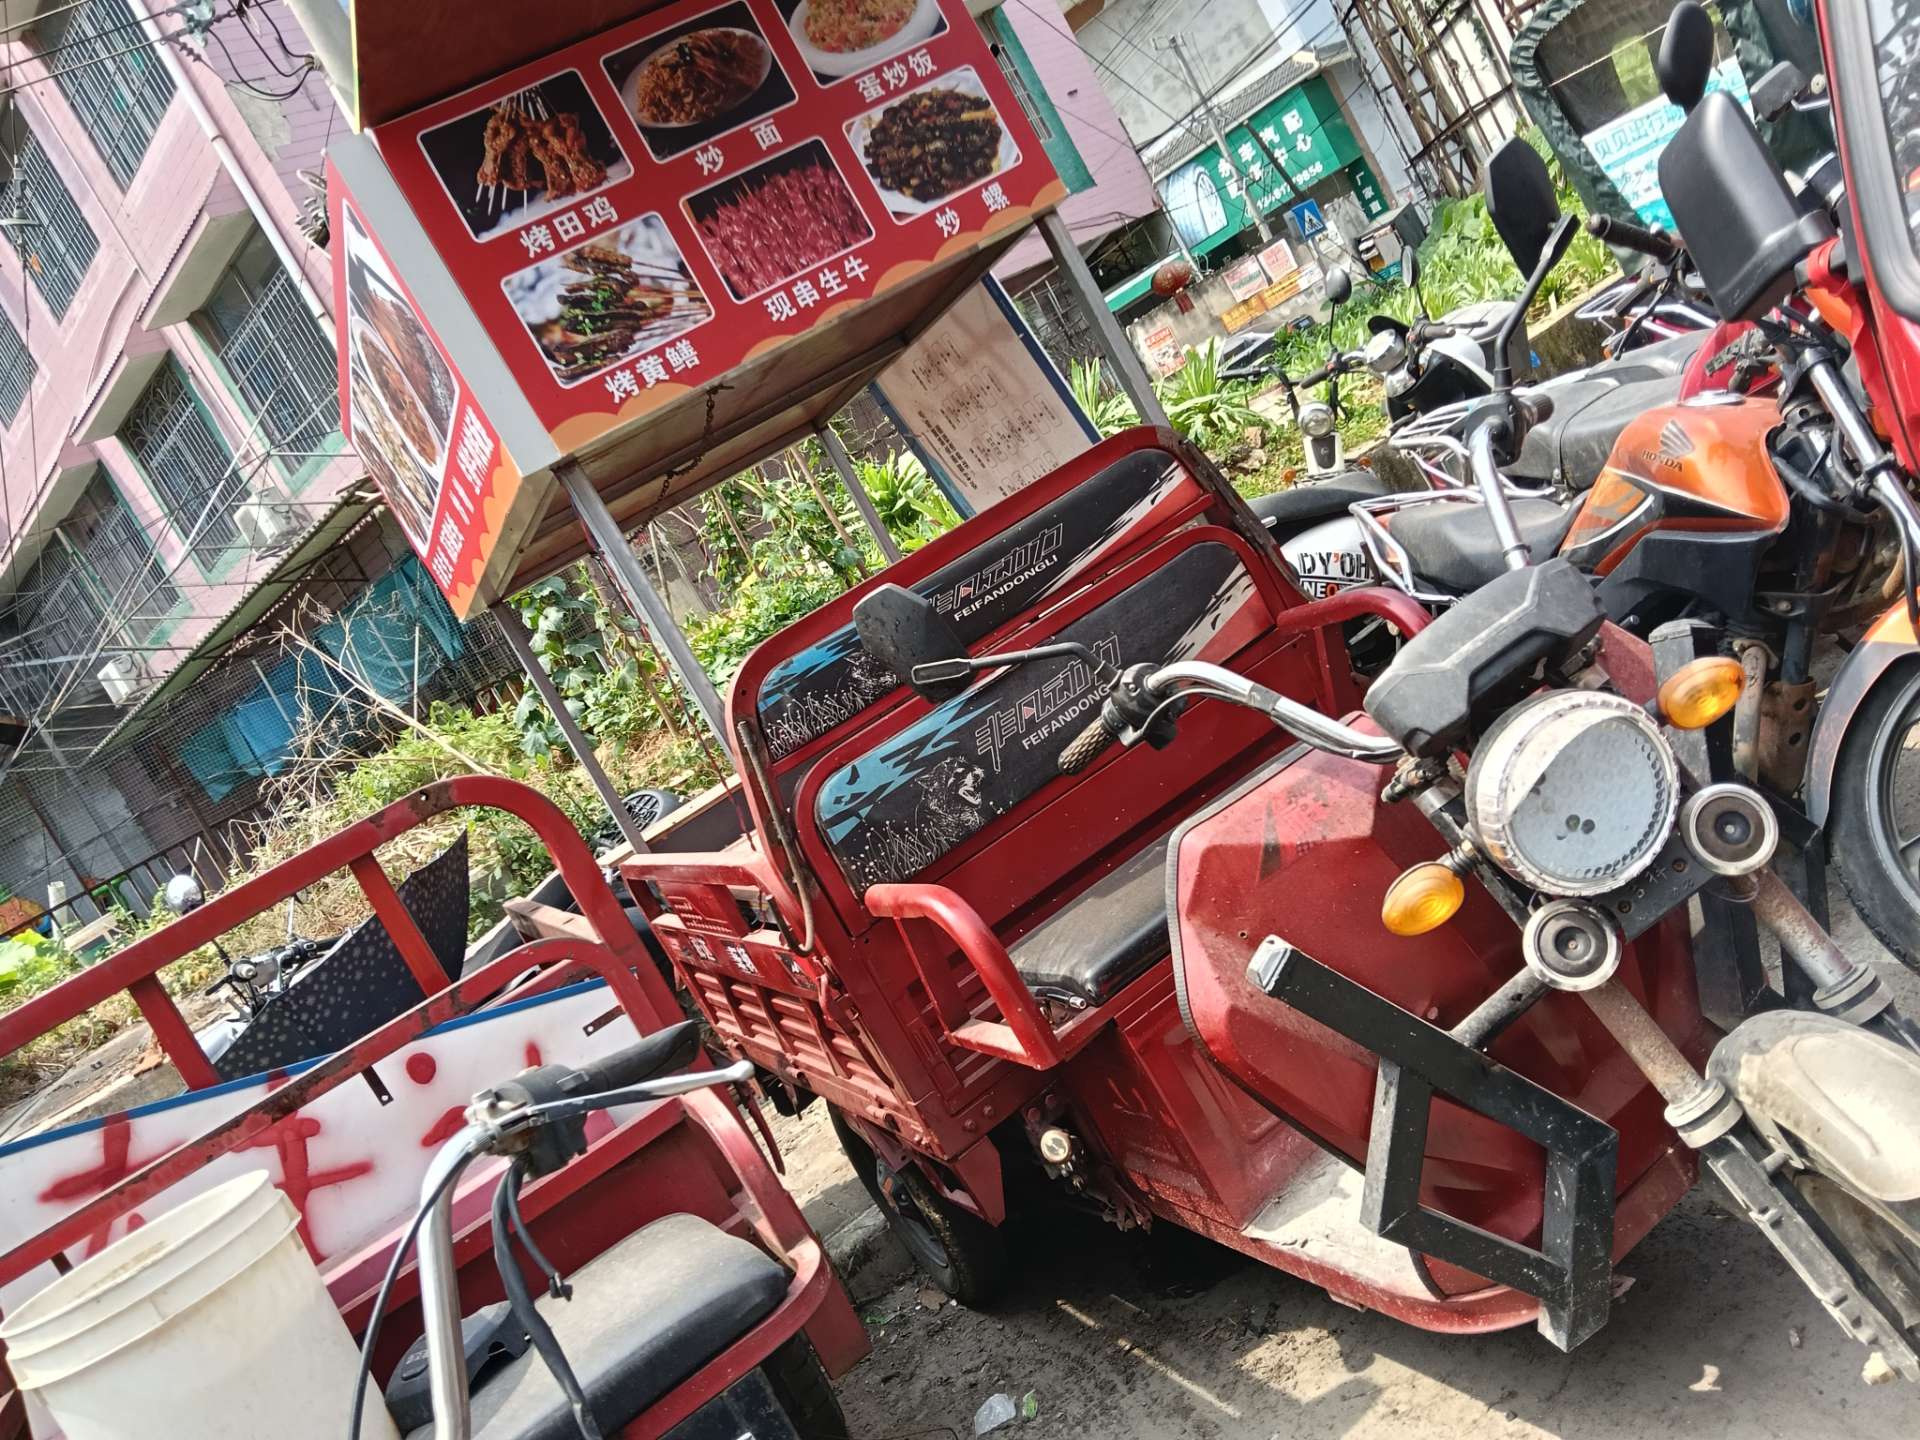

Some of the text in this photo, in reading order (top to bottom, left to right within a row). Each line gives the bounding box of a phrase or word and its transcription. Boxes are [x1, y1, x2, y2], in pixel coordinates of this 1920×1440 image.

[855, 48, 937, 103] 蛋炒饭
[695, 118, 783, 176] 炒面
[520, 196, 618, 258] 烤田鸡
[935, 182, 1010, 238] 炒螺
[763, 255, 869, 322] 现串生牛
[604, 339, 699, 404] 烤黄鳝
[1641, 449, 1683, 473] HONDA
[953, 554, 1058, 622] FEIFANDONGLI
